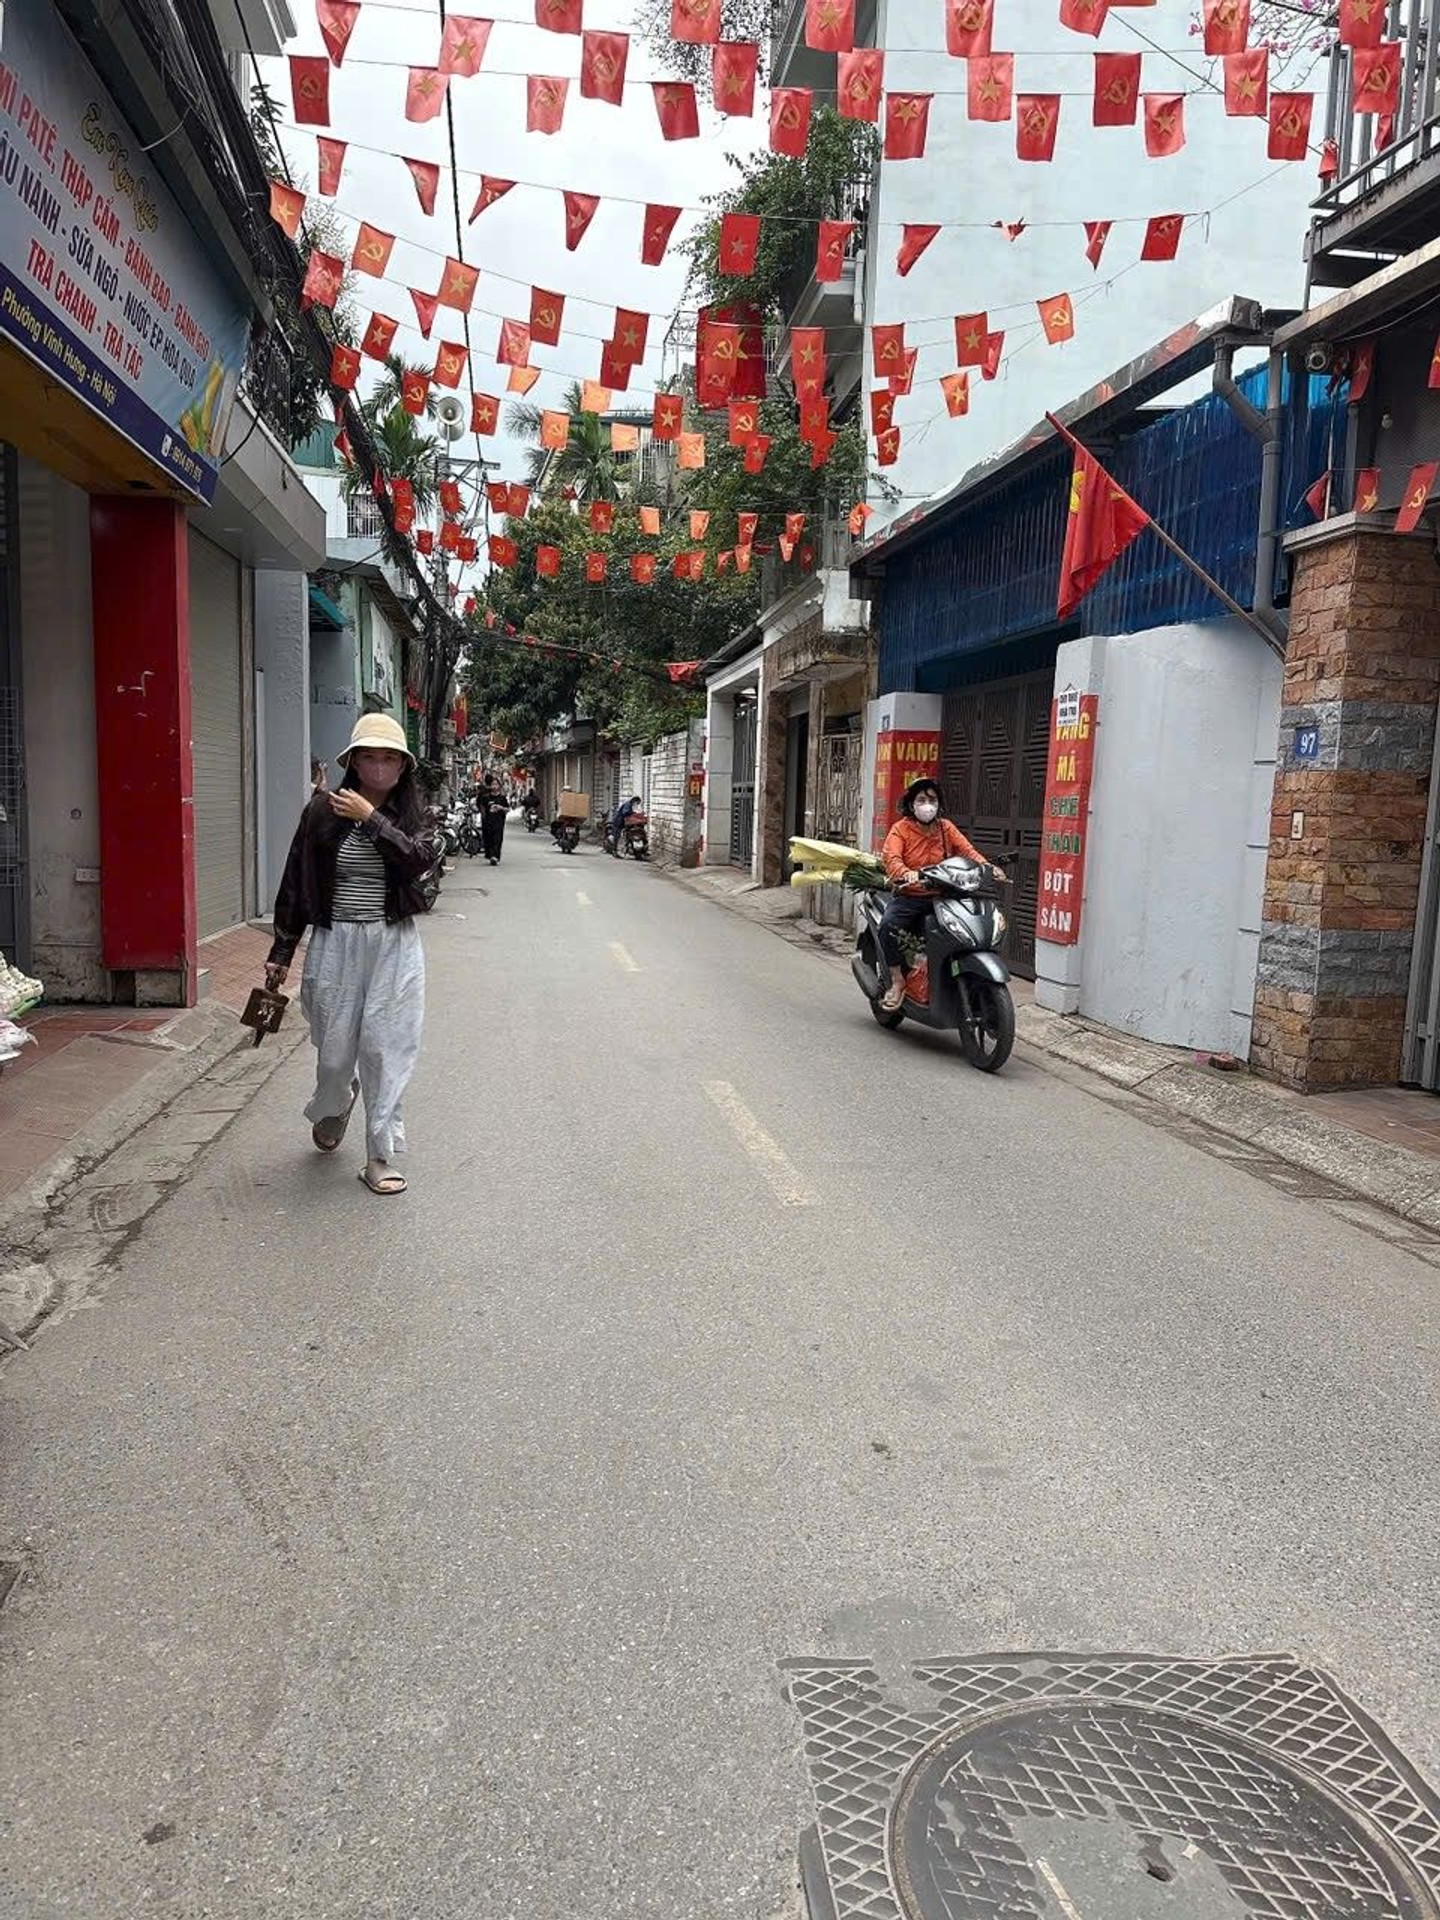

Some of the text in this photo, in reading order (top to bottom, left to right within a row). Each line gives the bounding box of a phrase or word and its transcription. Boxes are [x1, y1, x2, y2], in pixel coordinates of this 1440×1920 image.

[60, 147, 94, 209] THẬP
[124, 236, 154, 291] BÁNH
[151, 272, 171, 314] BAO
[17, 161, 62, 237] NÀNH
[123, 290, 152, 341] NƯỚC
[162, 336, 181, 375] HOA
[26, 238, 55, 292] TRÀ
[54, 270, 98, 335] CHANH
[42, 322, 65, 359] Vĩnh
[896, 738, 940, 763] VÀNG
[1301, 733, 1316, 754] 97
[1044, 868, 1074, 897] BỘT
[1040, 902, 1073, 933] SẮN
